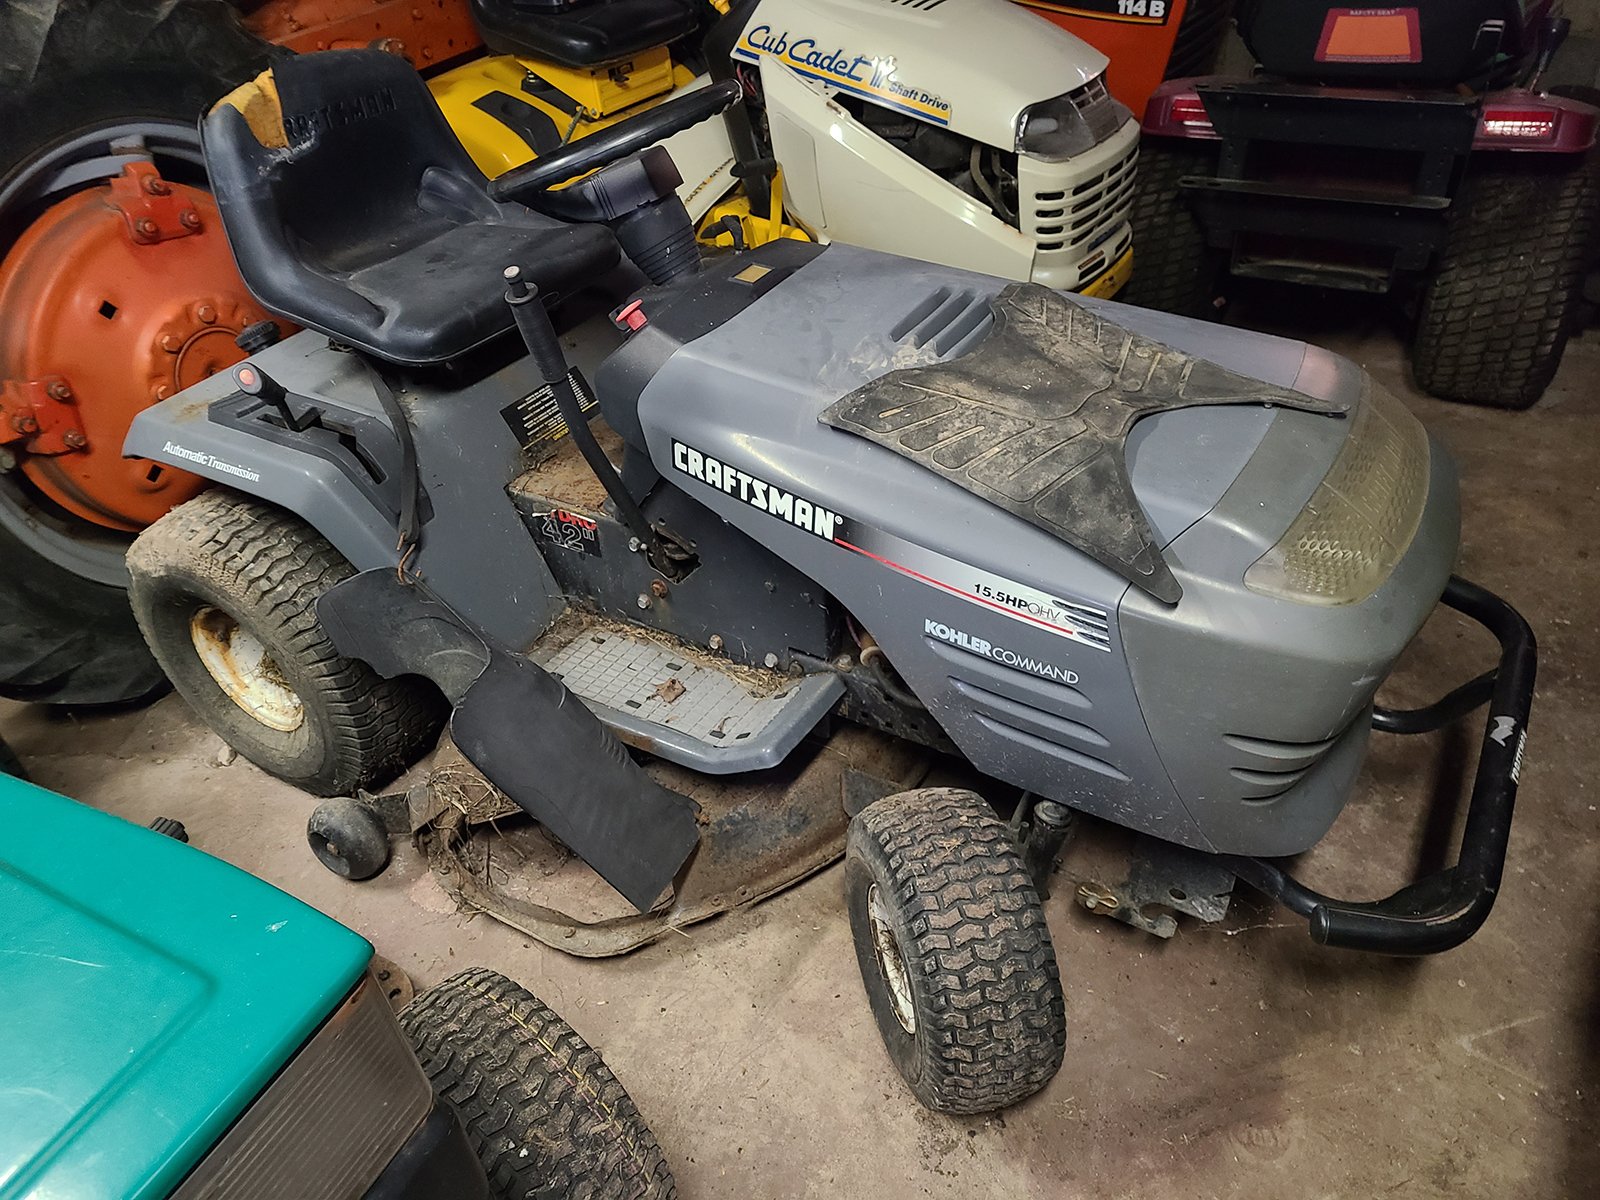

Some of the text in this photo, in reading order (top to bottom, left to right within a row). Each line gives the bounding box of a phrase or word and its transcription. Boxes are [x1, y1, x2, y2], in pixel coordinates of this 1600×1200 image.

[1118, 0, 1166, 17] 114 B
[747, 25, 873, 82] Cub Cadet
[888, 82, 950, 112] Shaft Drive
[162, 440, 260, 483] Automatic Transmission
[924, 618, 1079, 685] KOHLER COMMAND
